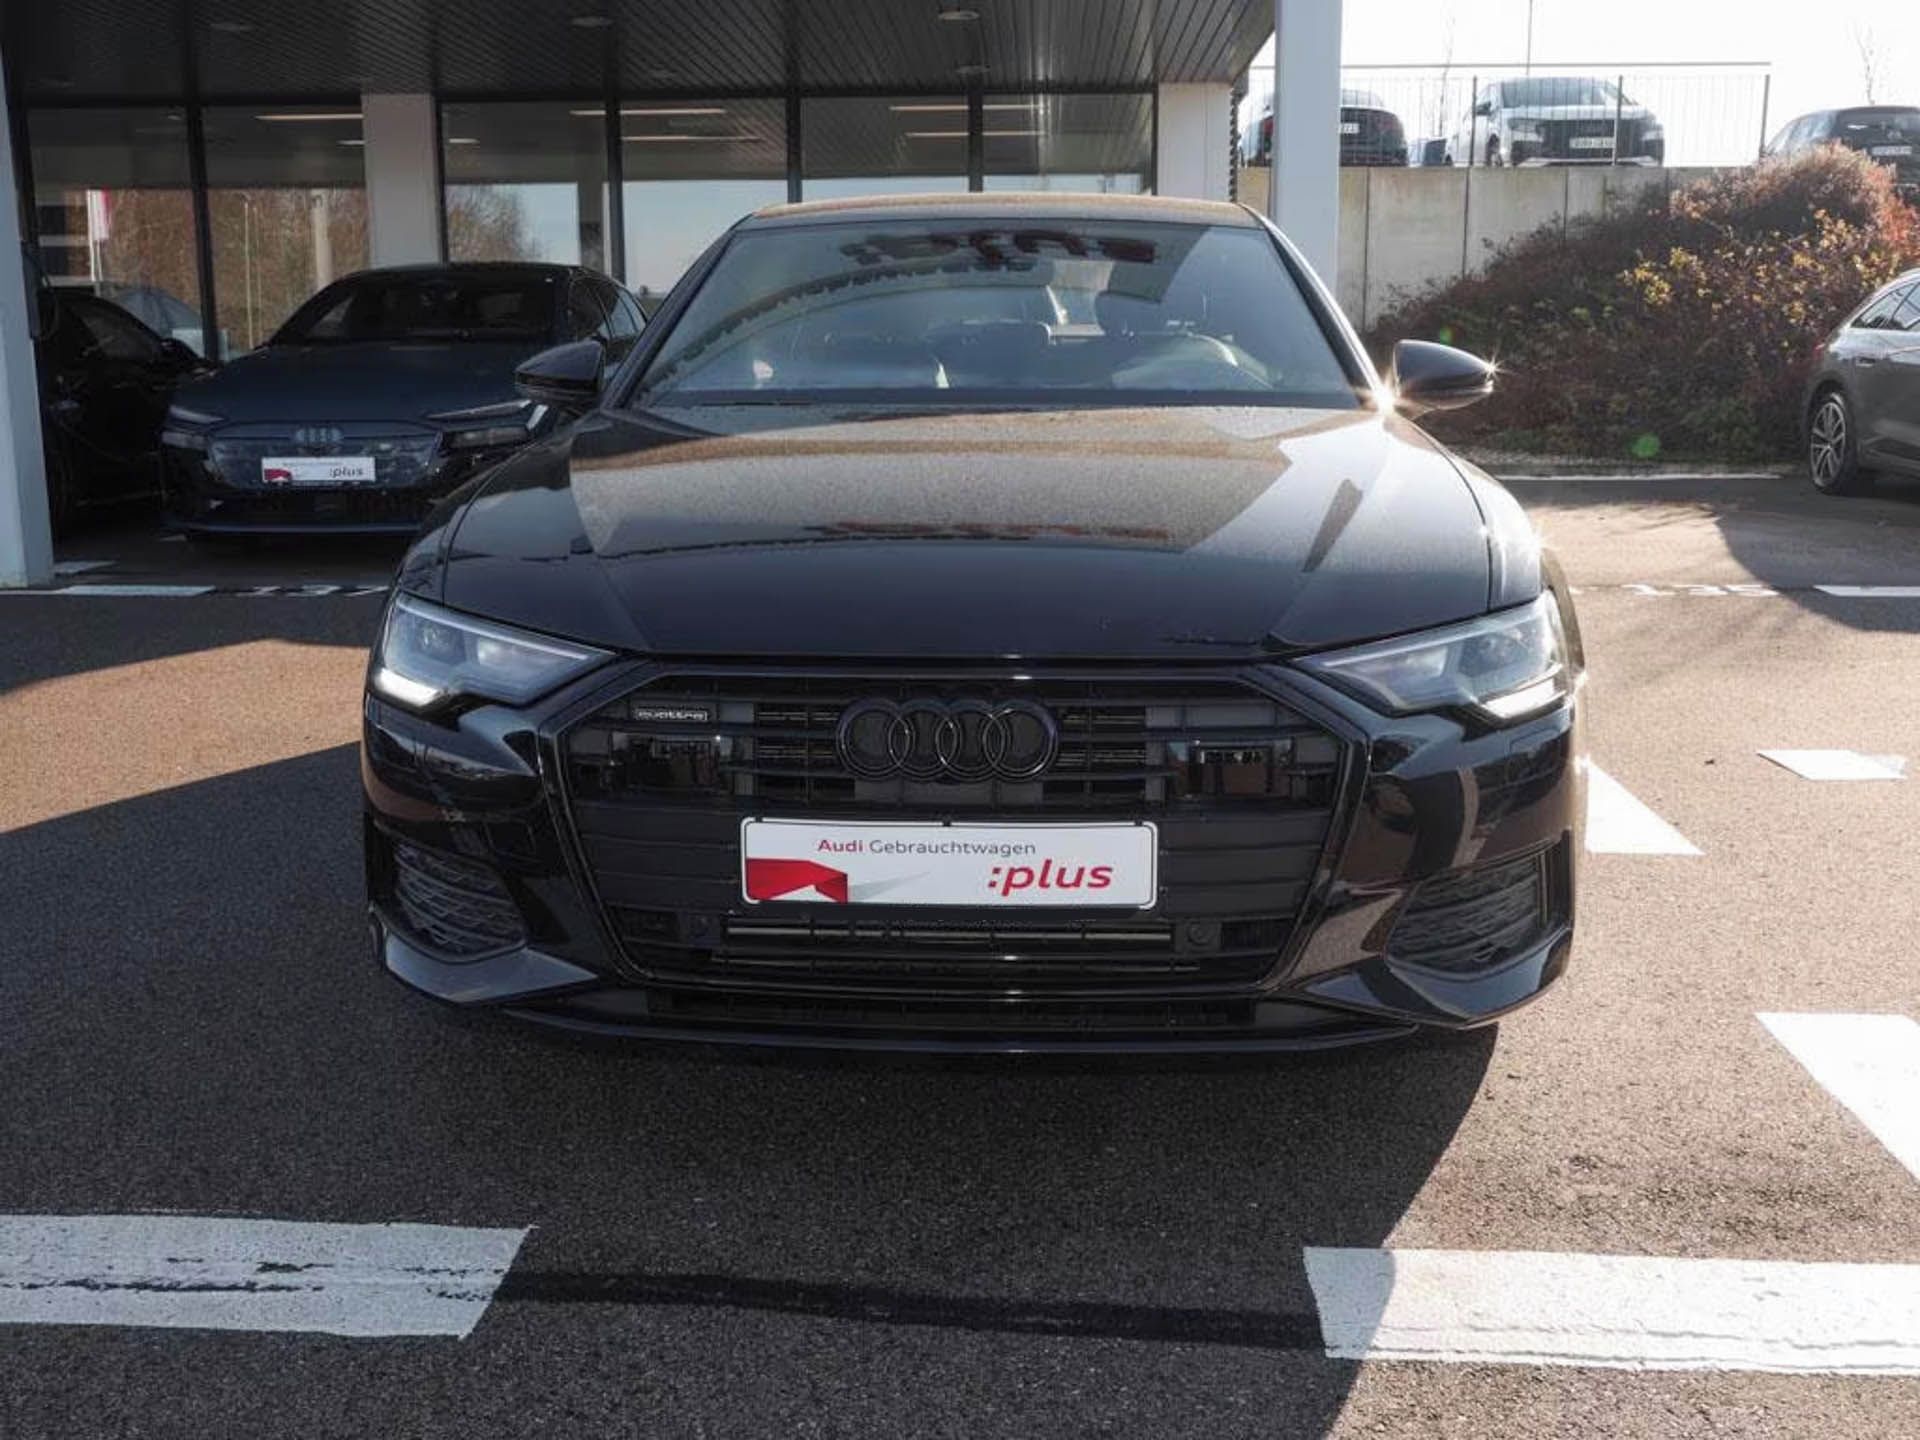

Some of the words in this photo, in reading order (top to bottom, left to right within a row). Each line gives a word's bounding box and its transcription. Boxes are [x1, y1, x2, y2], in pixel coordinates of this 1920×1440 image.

[817, 839, 863, 852] Audi
[869, 839, 1036, 857] Gebrauchtwagen
[988, 859, 1113, 896] :plus
